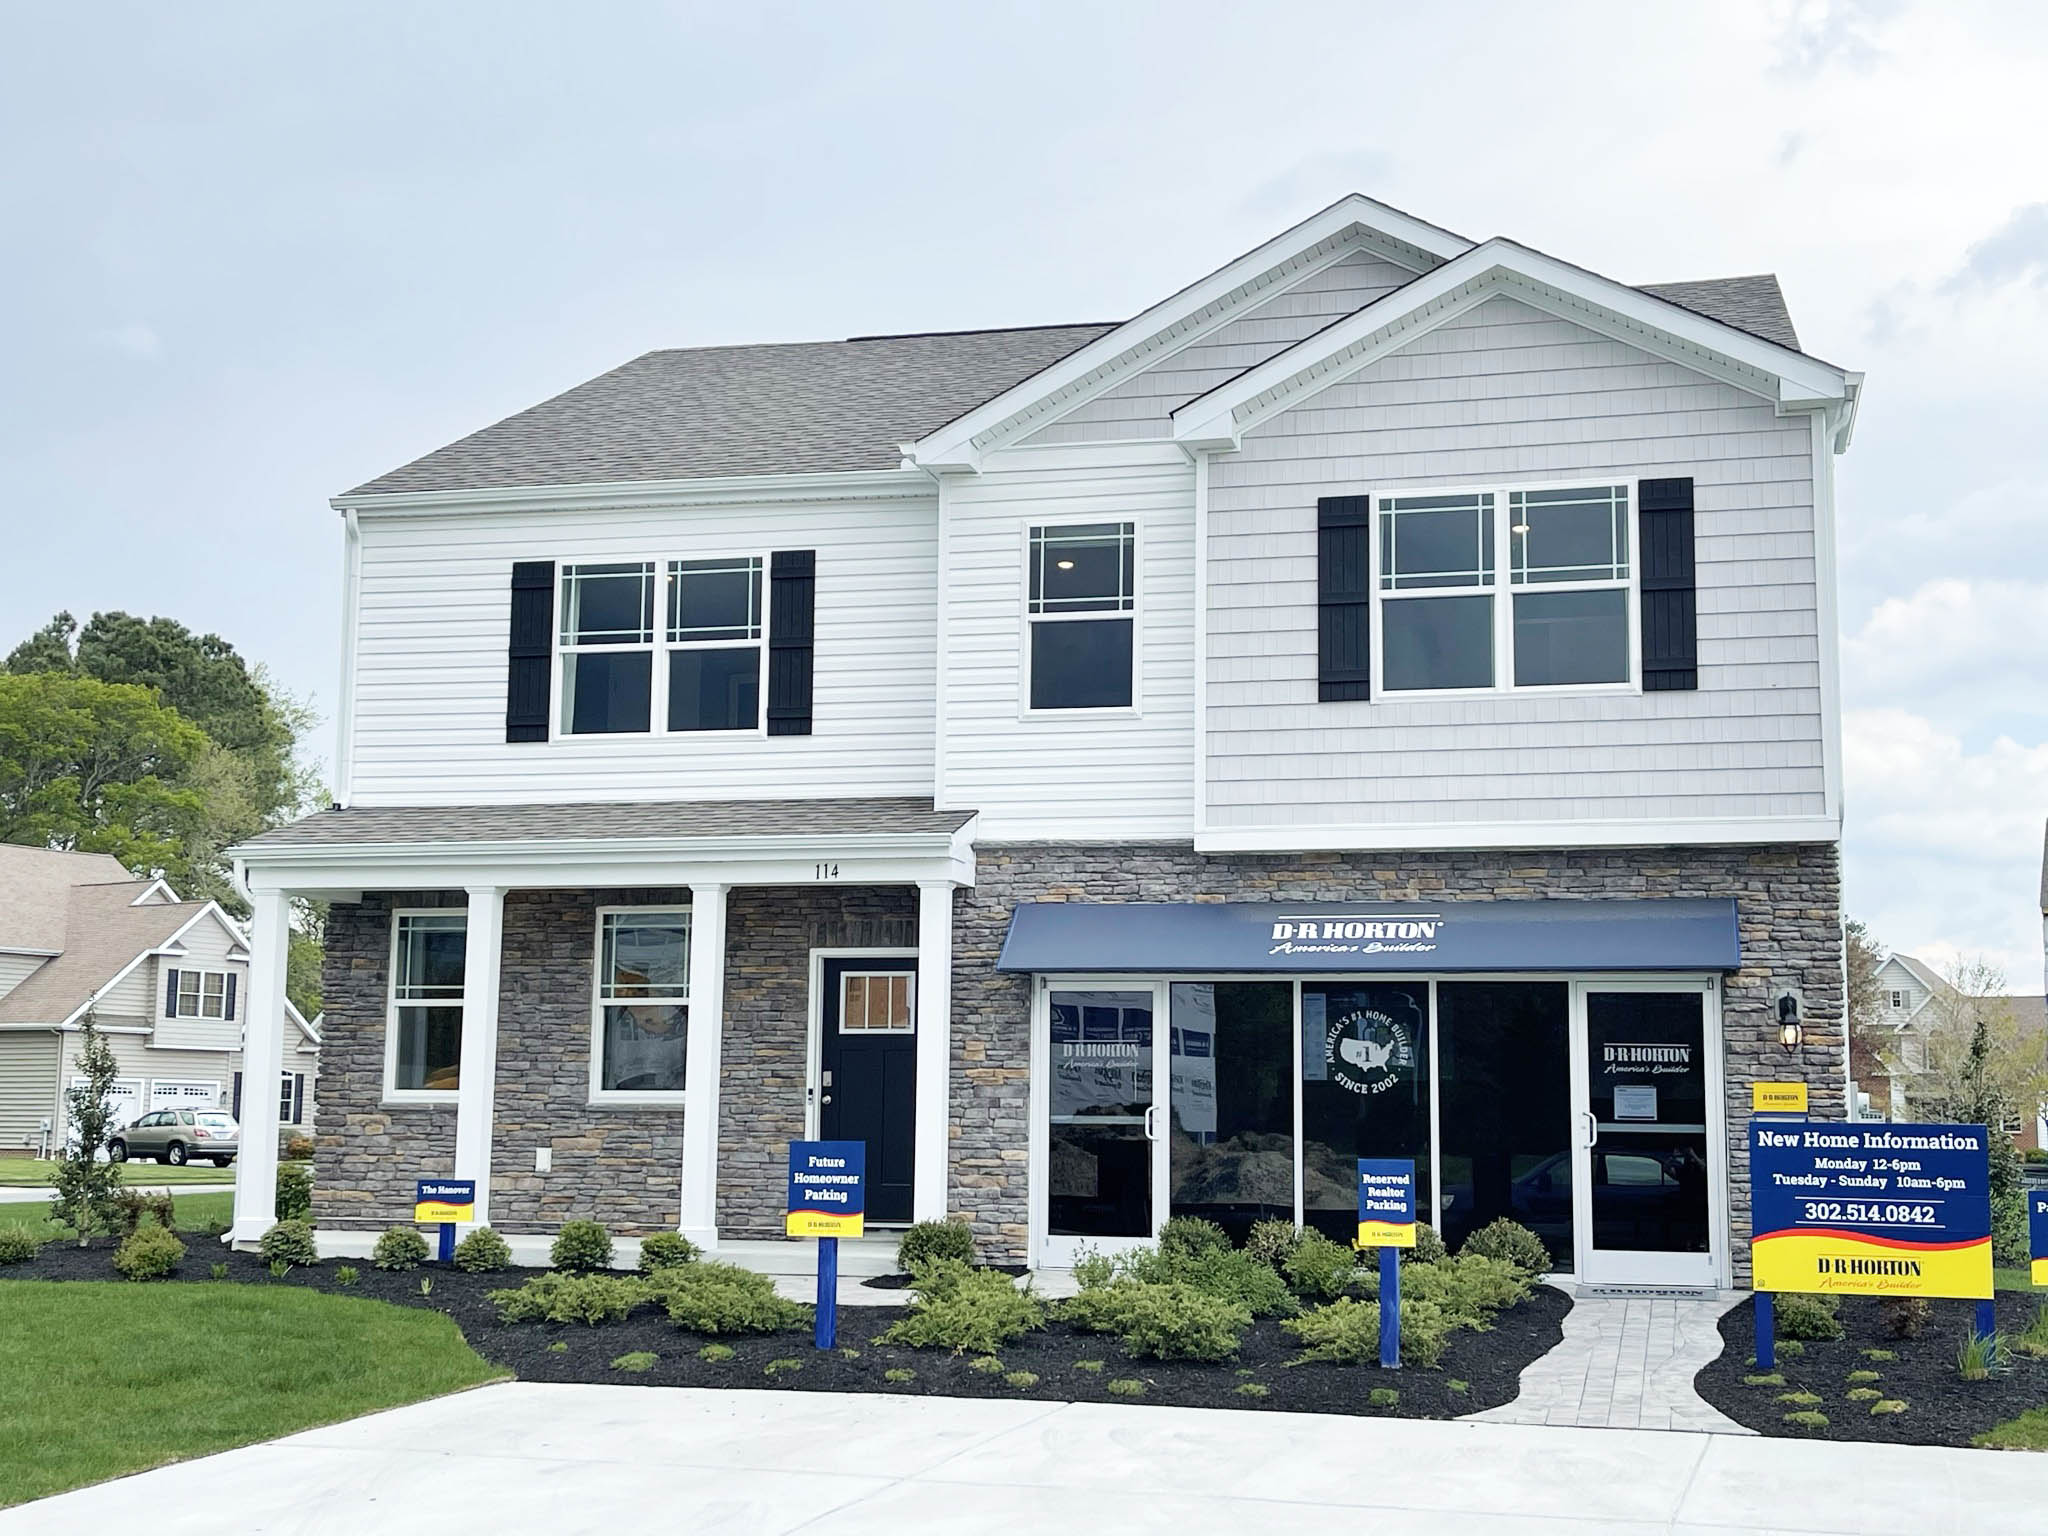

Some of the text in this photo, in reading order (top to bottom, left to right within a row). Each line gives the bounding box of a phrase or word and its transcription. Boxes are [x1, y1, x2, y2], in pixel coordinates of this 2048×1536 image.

[816, 863, 839, 880] 114
[1322, 921, 1437, 940] HORTON
[1362, 941, 1437, 954] Builder
[1325, 1016, 1350, 1064] AMERICA'S
[1365, 1010, 1393, 1027] HOME
[1391, 1023, 1409, 1066] BUILDER
[1334, 1072, 1399, 1094] SINCE 2002
[1757, 1130, 1980, 1151] New Home Information
[808, 1156, 846, 1168] Future
[1815, 1157, 1922, 1172] Monday 12-6pm
[793, 1172, 860, 1184] Homeowner
[1362, 1173, 1410, 1185] Reserved
[1773, 1173, 1828, 1188] Tuesday
[1838, 1175, 1888, 1190] Sunday
[1896, 1176, 1967, 1191] 10am-6pm
[422, 1184, 471, 1195] The Hanover
[804, 1188, 848, 1204] Parking
[1367, 1186, 1406, 1198] Realtor
[1366, 1199, 1408, 1213] Parking
[1804, 1202, 1936, 1223] 302.514.0842
[1876, 1279, 1922, 1290] Builder
